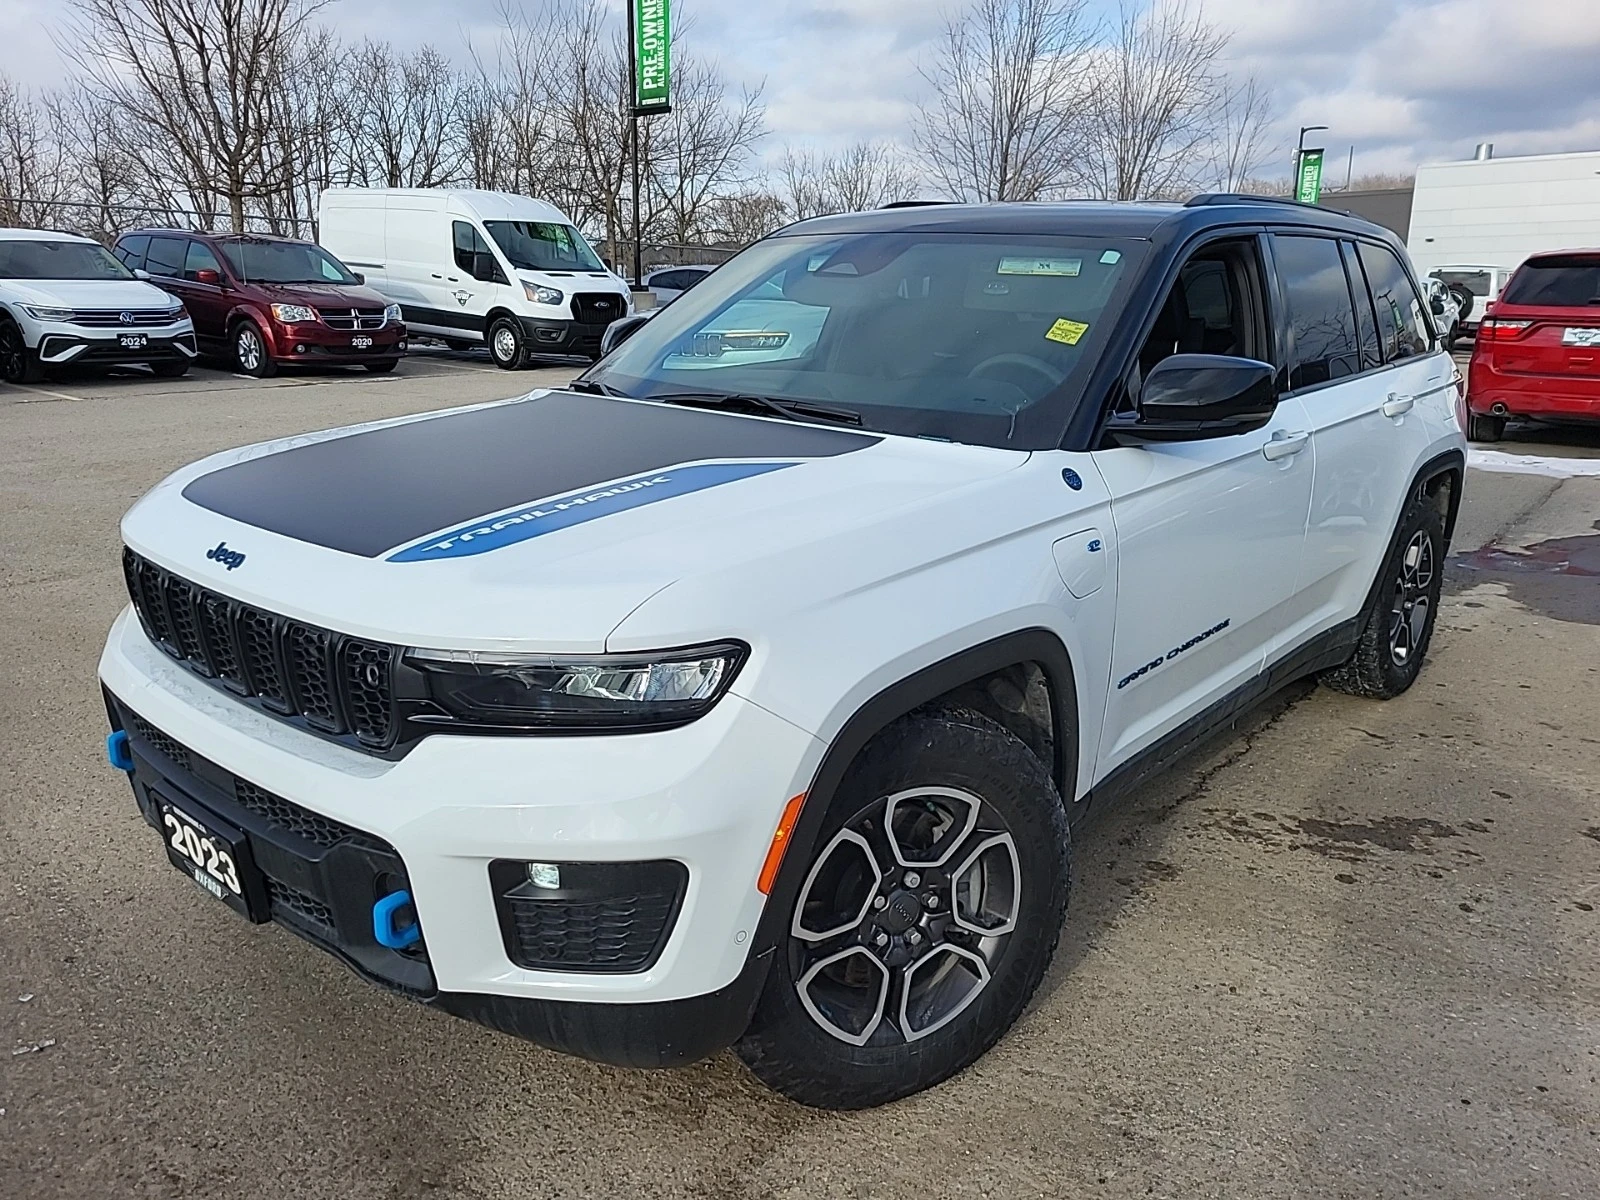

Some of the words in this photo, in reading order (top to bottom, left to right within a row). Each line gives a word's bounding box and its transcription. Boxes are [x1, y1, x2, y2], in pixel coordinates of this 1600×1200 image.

[656, 18, 665, 38] AND
[656, 39, 665, 69] MAKES
[657, 71, 665, 88] ALL
[120, 337, 147, 346] 2024
[351, 337, 373, 346] 2020
[421, 475, 672, 552] TRAILHAWK
[206, 541, 247, 571] Jeep
[1117, 656, 1164, 690] GRAND
[1165, 618, 1231, 660] CHEROKEE
[164, 813, 242, 895] 2023
